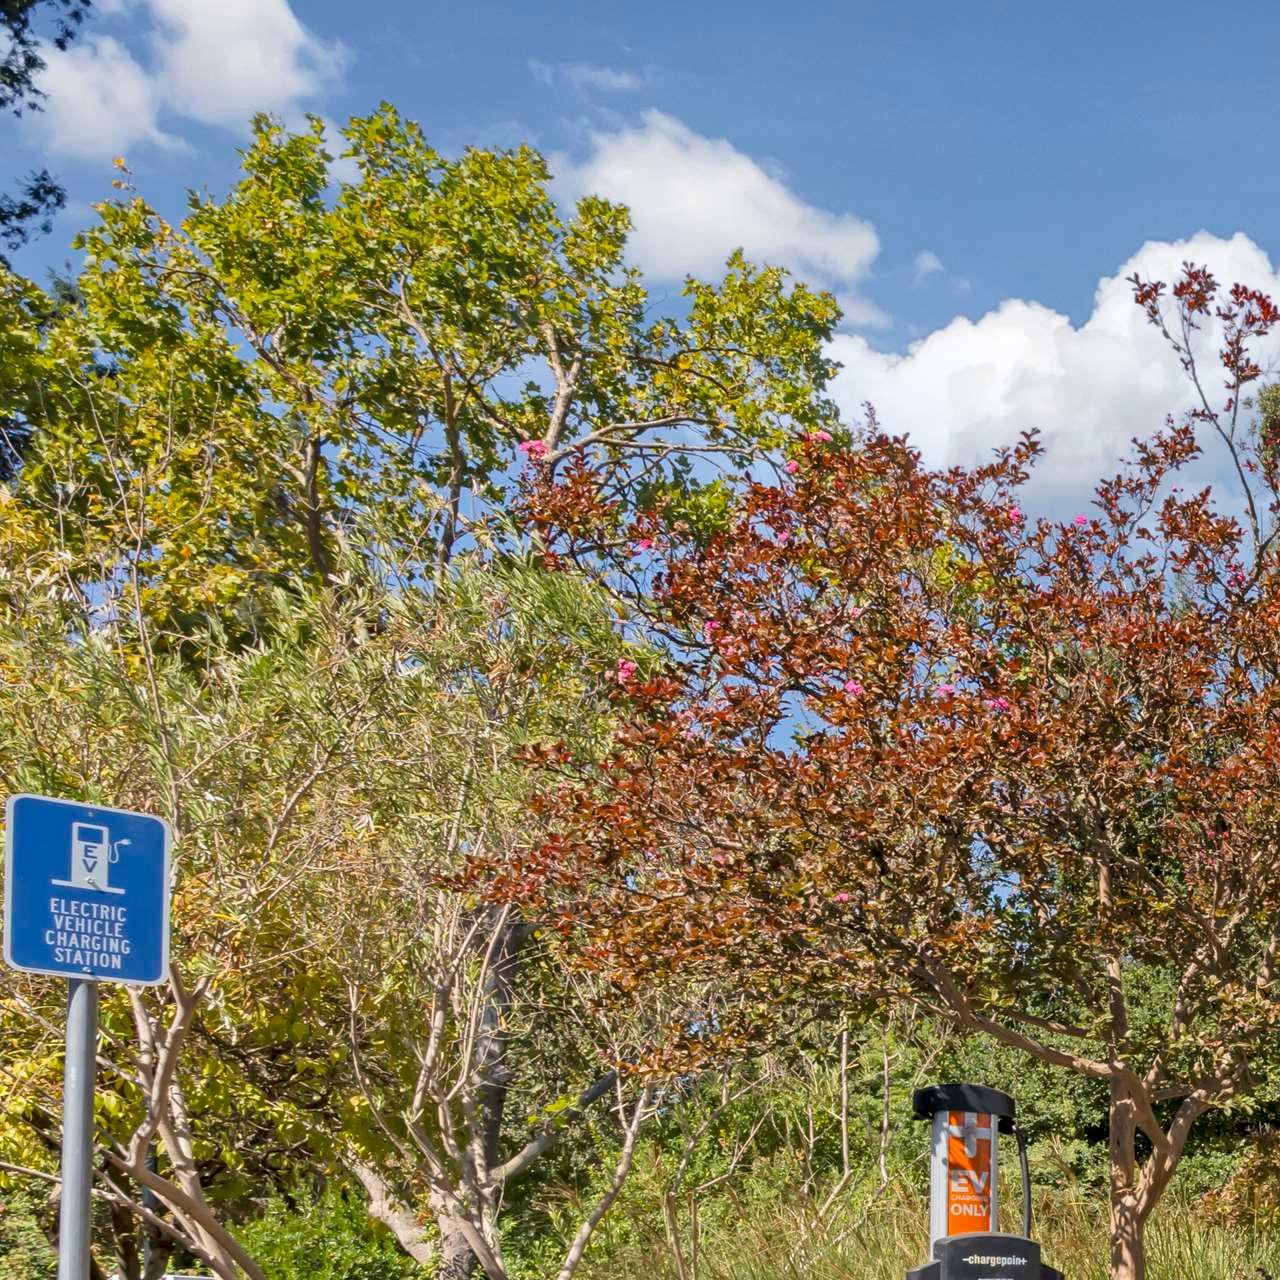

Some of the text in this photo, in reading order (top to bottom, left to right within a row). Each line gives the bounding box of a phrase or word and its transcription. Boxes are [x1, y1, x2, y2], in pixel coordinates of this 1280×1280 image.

[83, 844, 98, 873] EV
[50, 897, 127, 922] ELECTRIC
[54, 914, 123, 938] VEHICLE
[45, 930, 131, 954] CHARGING
[54, 947, 122, 969] STATION
[951, 1169, 988, 1193] EV
[951, 1203, 989, 1216] ONLY
